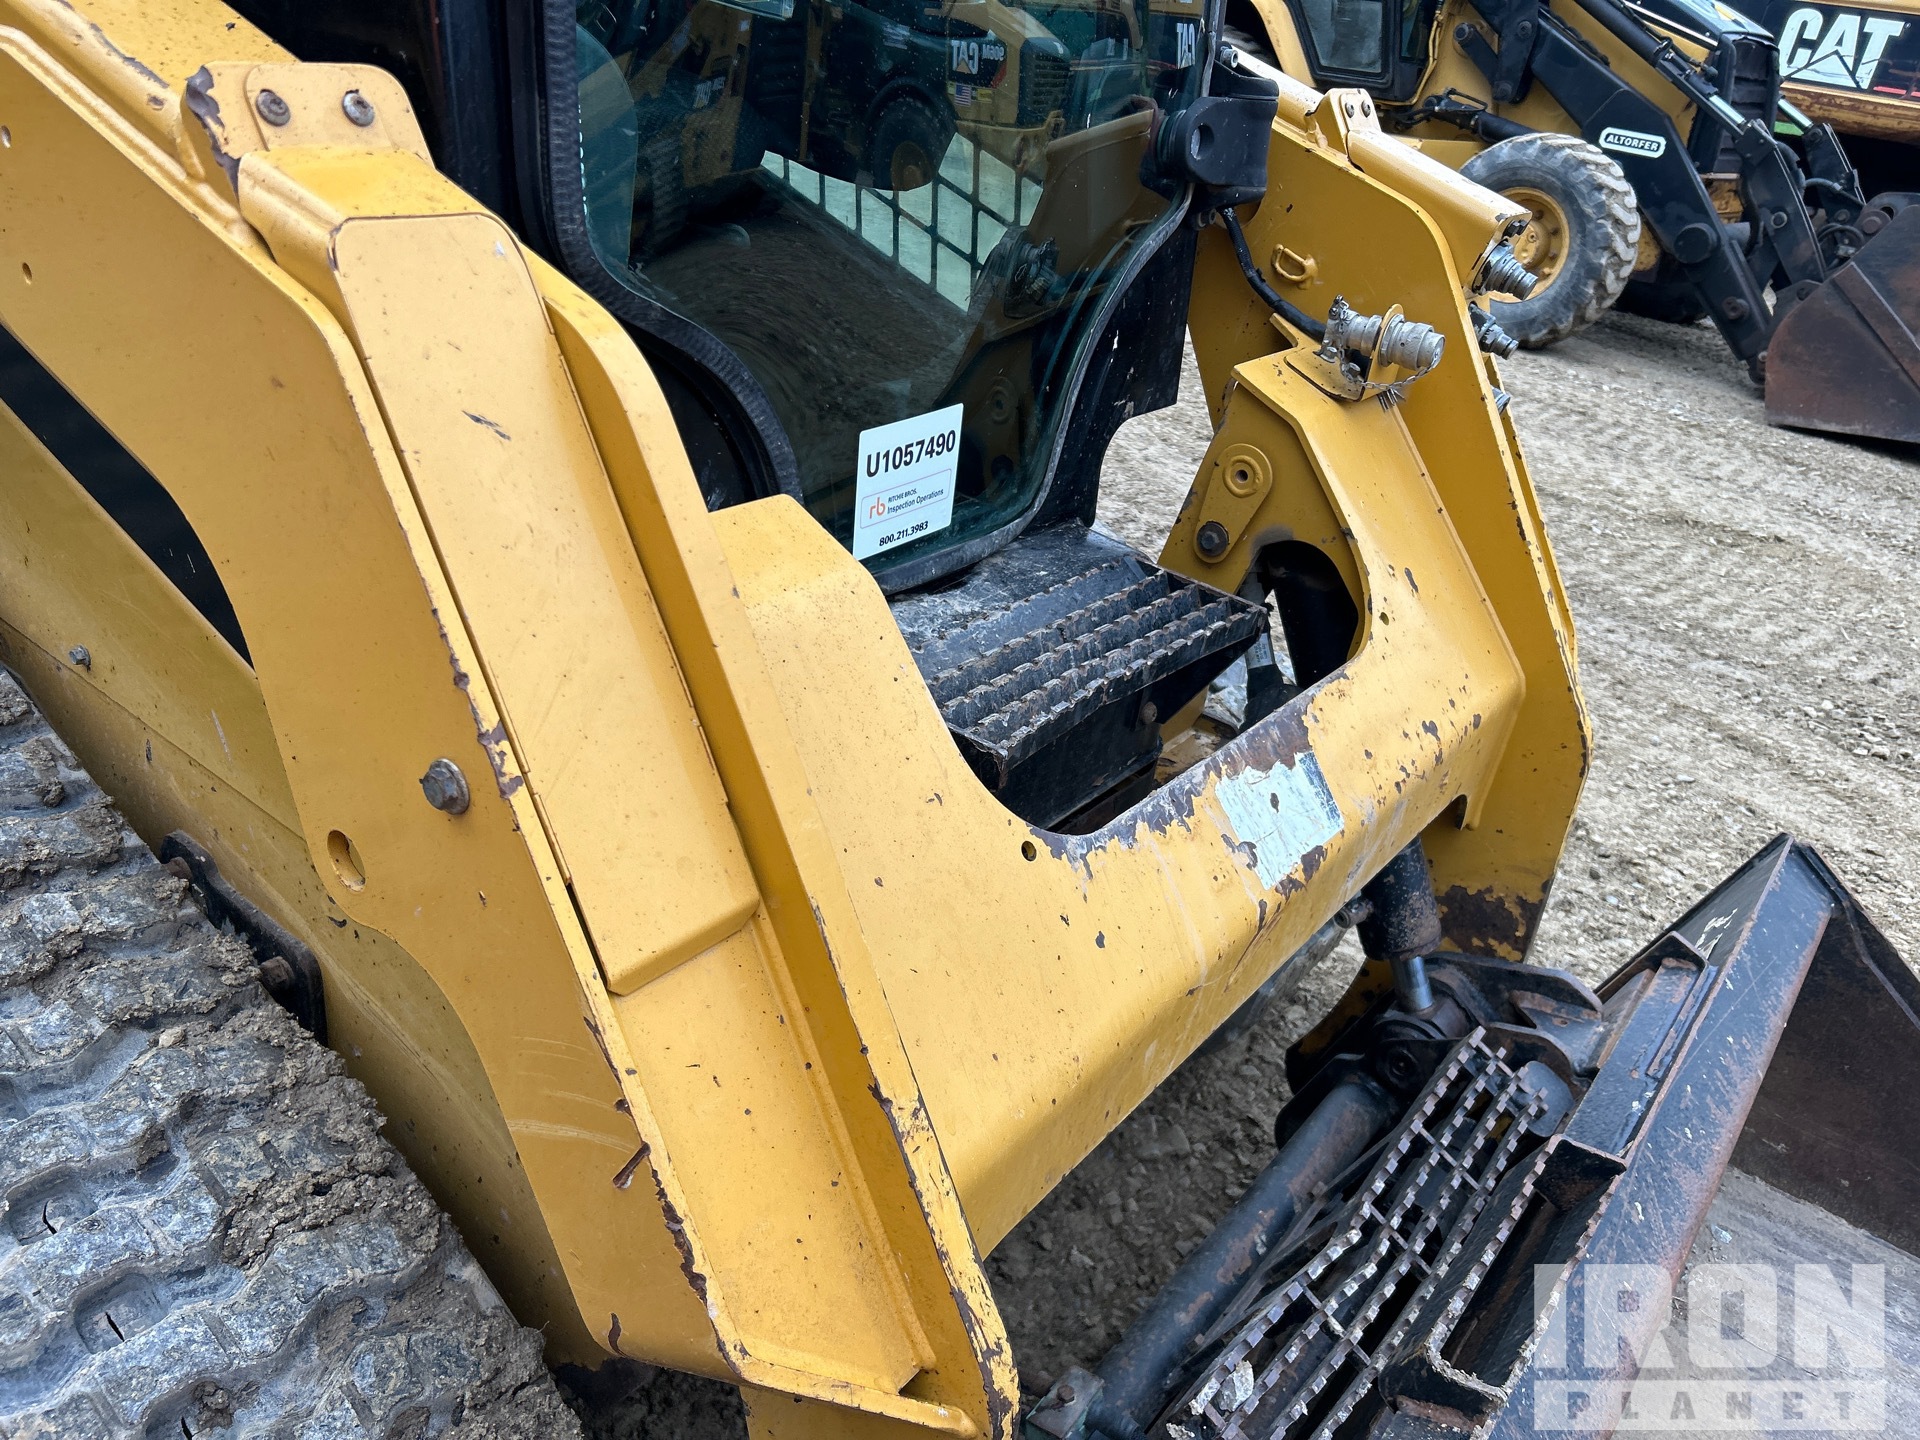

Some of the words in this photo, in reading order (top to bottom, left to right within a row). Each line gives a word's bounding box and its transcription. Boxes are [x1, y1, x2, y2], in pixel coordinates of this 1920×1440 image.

[1778, 8, 1904, 90] CAT
[1605, 133, 1659, 152] ALTORFER
[866, 430, 956, 477] U1057490
[869, 497, 886, 519] rb
[887, 499, 915, 514] Inspection
[916, 489, 944, 504] Operations
[888, 493, 904, 503] RITCHIE
[879, 521, 928, 546] 800.211.3983
